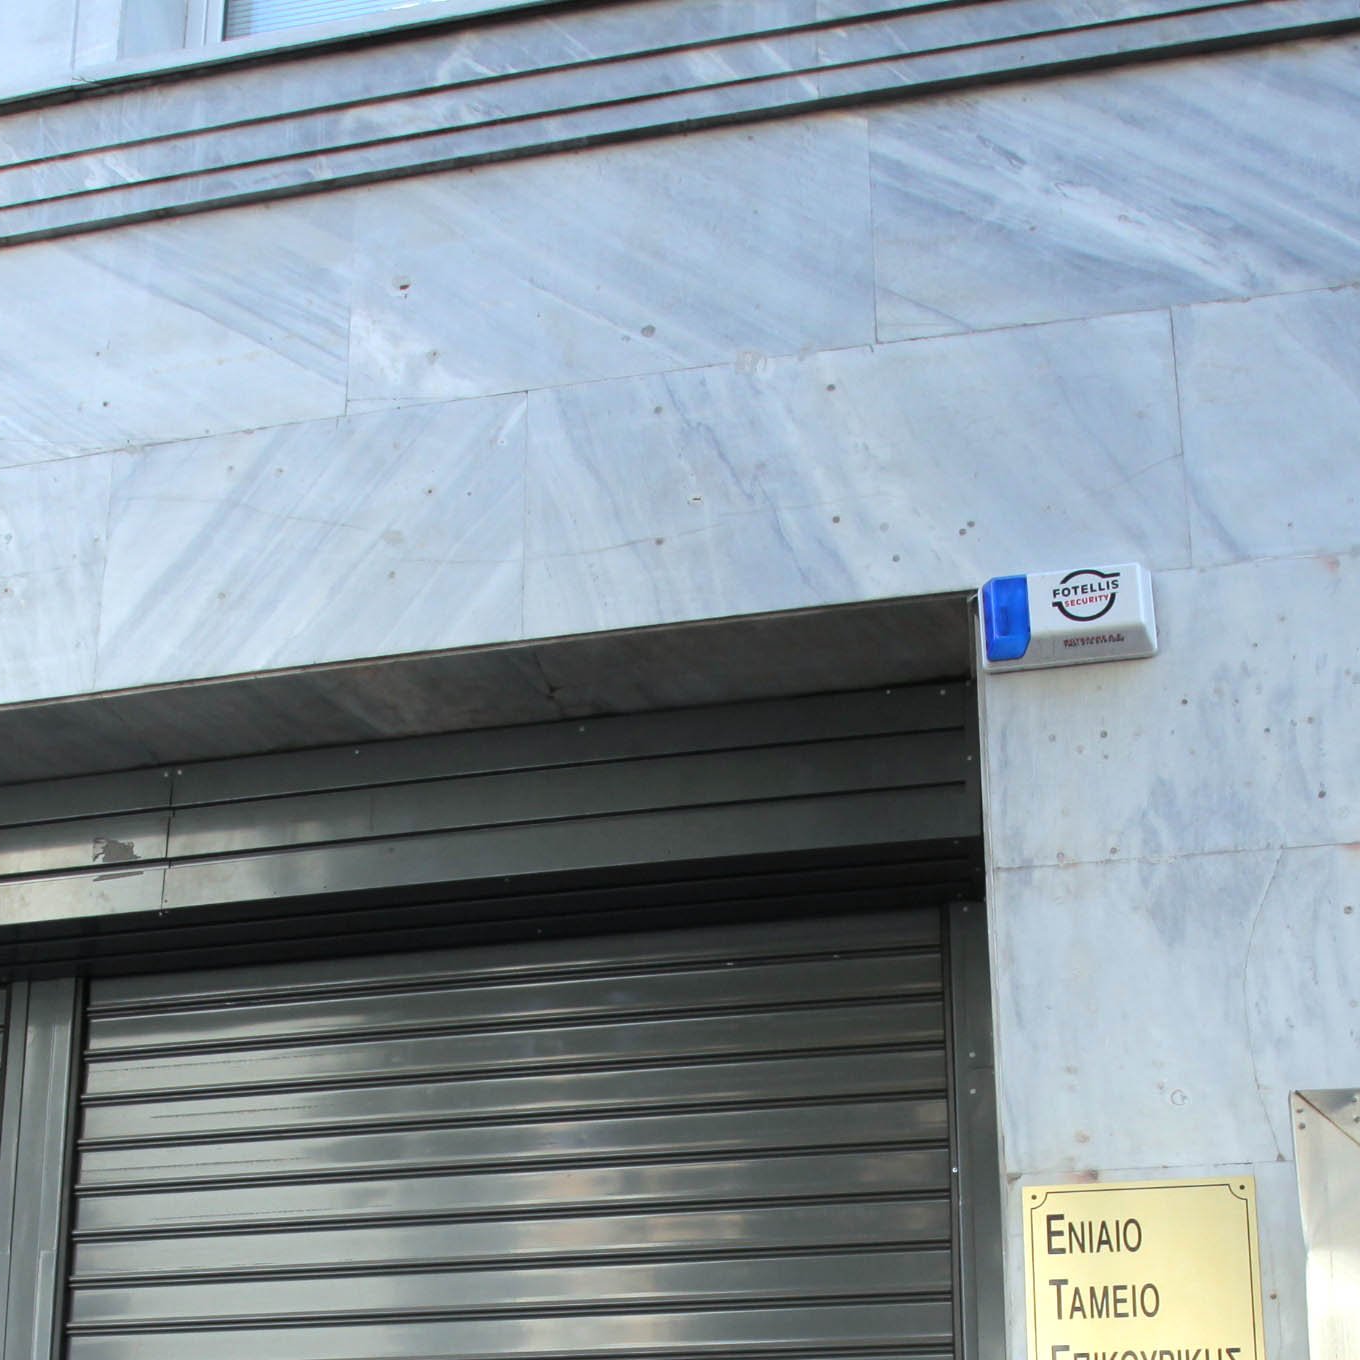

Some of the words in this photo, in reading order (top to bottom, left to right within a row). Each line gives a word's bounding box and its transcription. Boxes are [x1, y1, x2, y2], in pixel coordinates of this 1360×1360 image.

[1052, 579, 1119, 599] FOTELLIS
[1064, 594, 1109, 607] SECURITY
[1045, 1213, 1143, 1255] ΕΝΙΑΙΟ
[1048, 1278, 1160, 1320] ΤΑΜΕΙΟ
